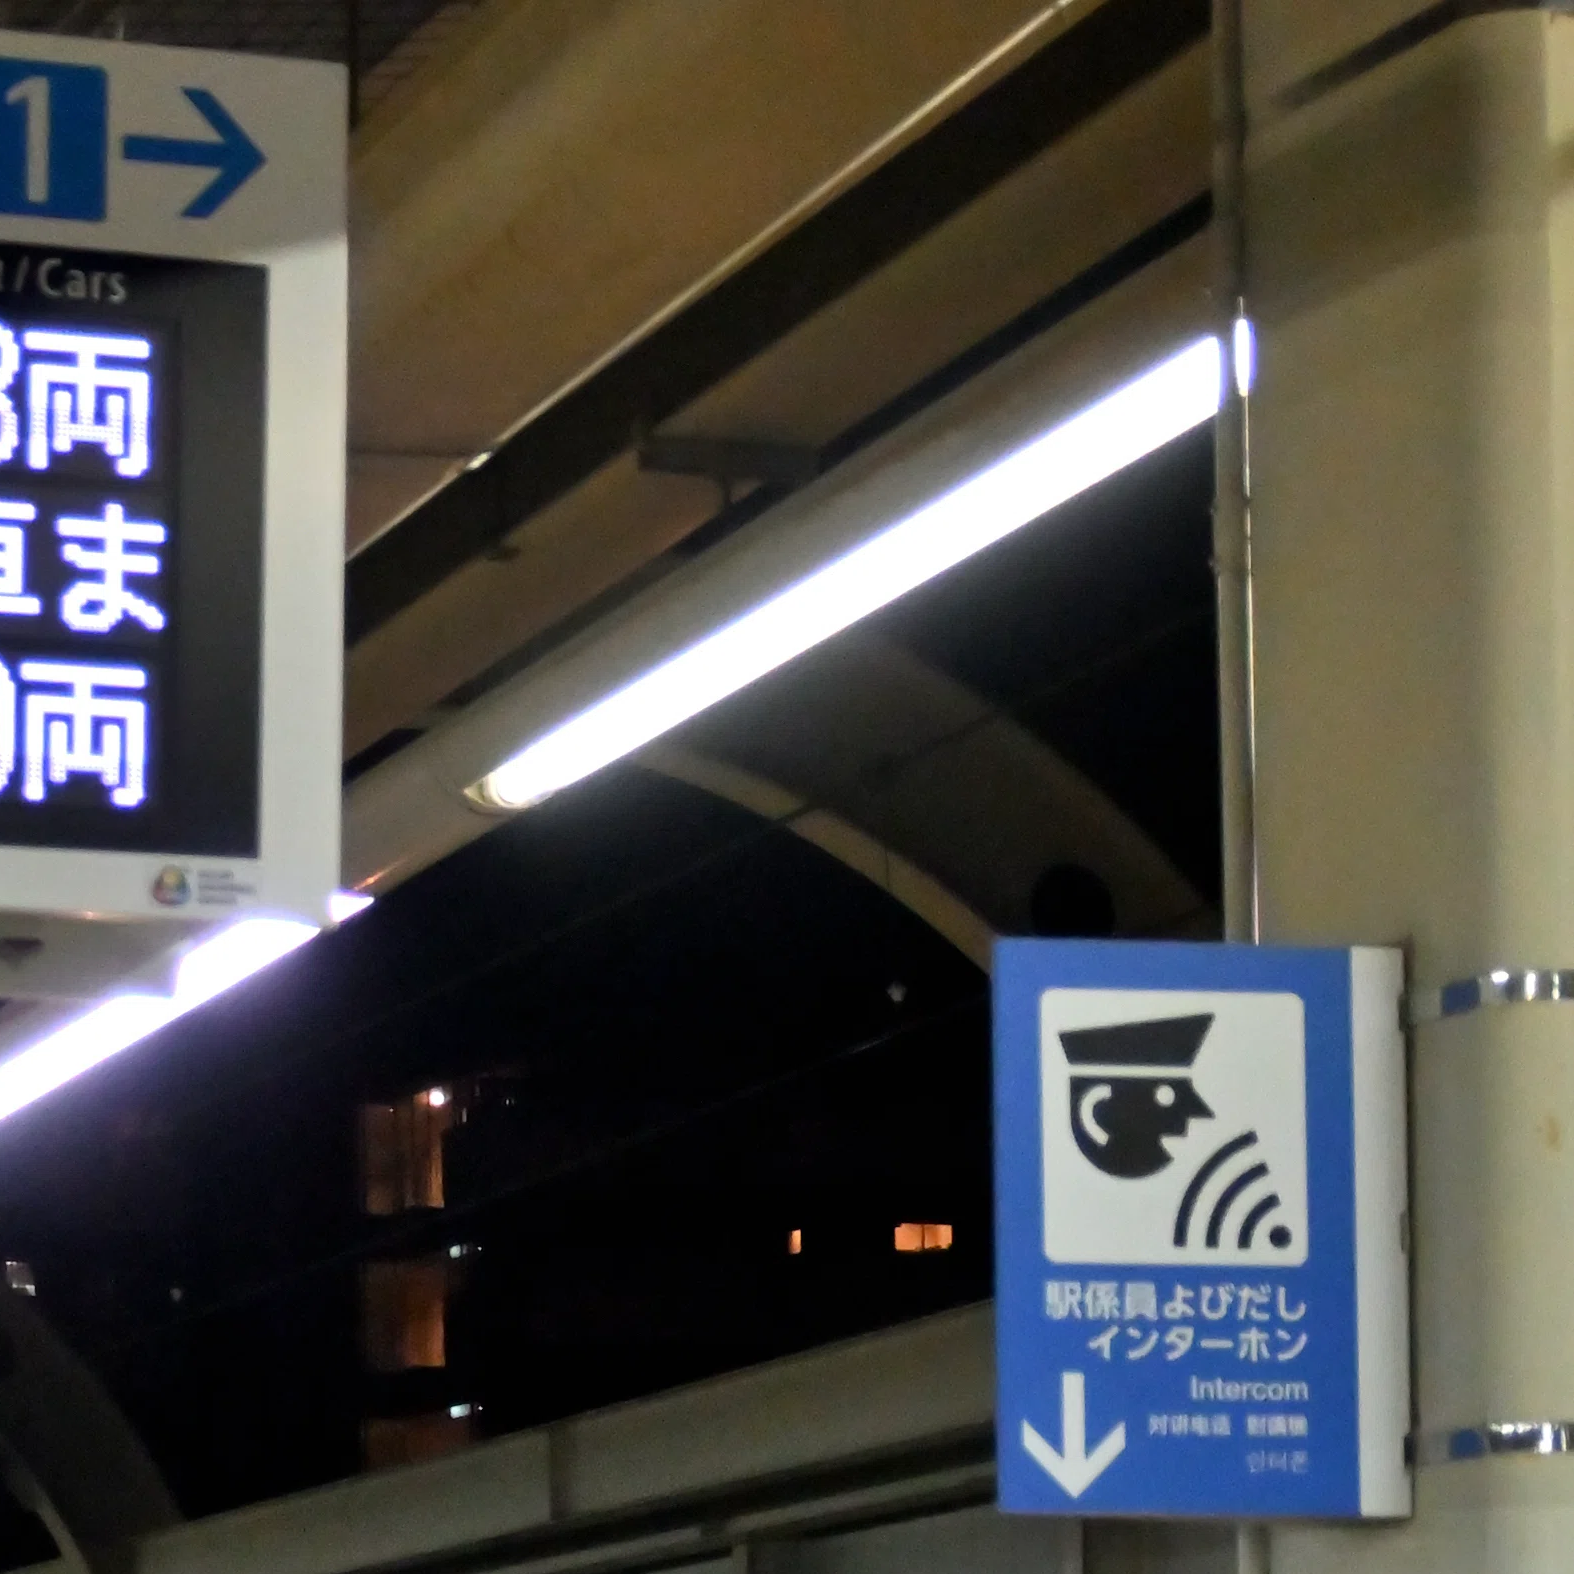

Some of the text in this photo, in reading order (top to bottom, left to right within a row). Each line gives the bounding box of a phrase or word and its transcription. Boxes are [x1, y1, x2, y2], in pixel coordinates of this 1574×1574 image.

[3, 76, 53, 205] 1
[37, 258, 130, 305] Cars
[1088, 1325, 1309, 1363] インターホン
[1190, 1374, 1309, 1402] Intercom
